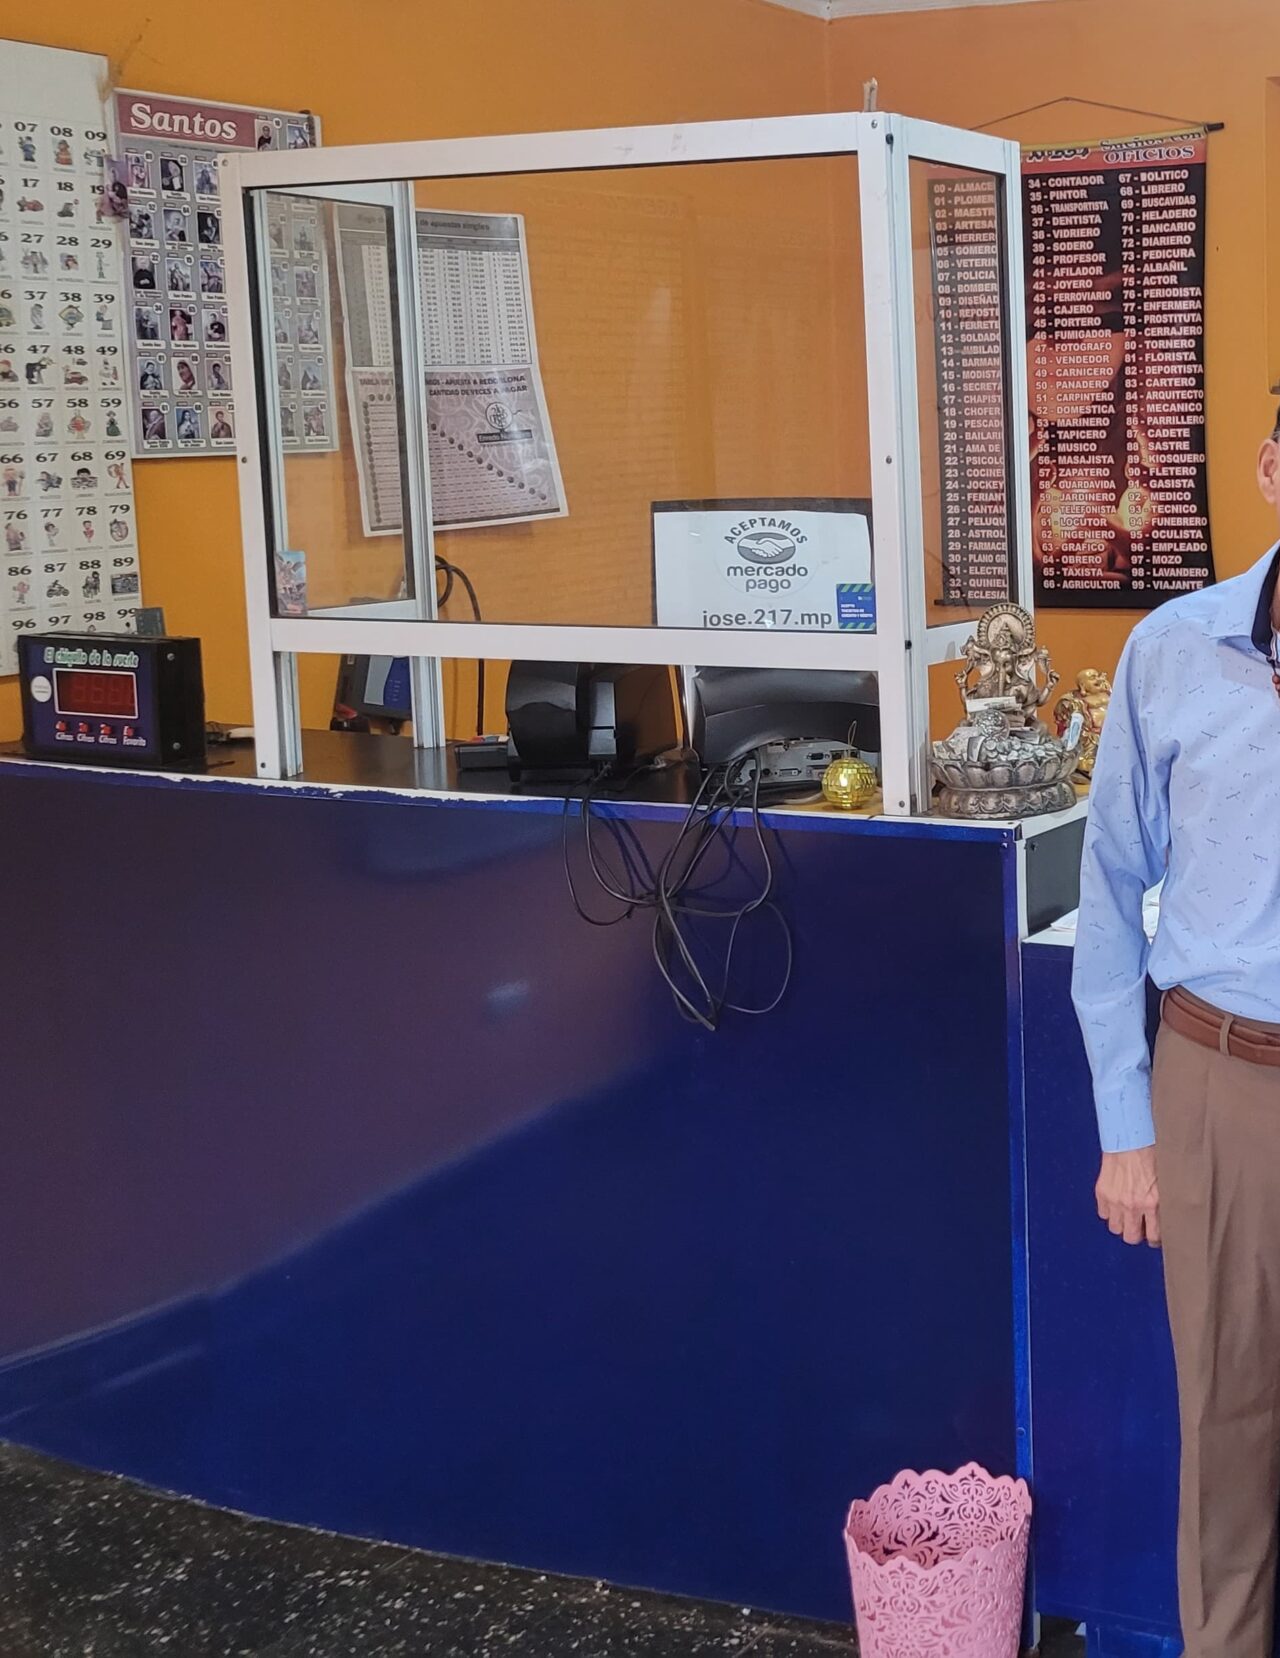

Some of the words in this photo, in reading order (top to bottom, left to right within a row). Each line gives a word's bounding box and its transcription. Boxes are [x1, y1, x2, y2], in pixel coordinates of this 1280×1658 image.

[131, 102, 237, 139] Santos
[14, 122, 38, 133] 07
[51, 126, 73, 137] 08
[85, 131, 107, 141] 09
[1104, 146, 1195, 164] OFICIOS
[57, 182, 73, 191] 18
[1028, 179, 1041, 188] 34
[1048, 175, 1104, 187] CONTADOR
[1120, 186, 1134, 196] 68
[1141, 183, 1185, 195] LIBRERO
[1122, 212, 1134, 222] 70
[1142, 208, 1197, 221] HELADERO
[1032, 217, 1044, 227] 37
[1052, 215, 1102, 225] DENTISTA
[21, 233, 44, 243] 27
[57, 236, 78, 246] 28
[90, 239, 112, 249] 29
[1032, 243, 1045, 253] 39
[1053, 241, 1094, 251] SODERO
[1033, 269, 1045, 278] 41
[1053, 266, 1103, 277] AFILADOR
[1122, 264, 1135, 274] 74
[1142, 261, 1187, 272] ALBAÑIL
[938, 272, 950, 281] 07
[957, 269, 995, 280] POLICIA
[24, 290, 47, 300] 37
[1123, 290, 1136, 299] 76
[1144, 288, 1202, 298] PERIODISTA
[1033, 306, 1046, 316] 44
[1054, 304, 1093, 315] CAJERO
[1034, 344, 1047, 353] 47
[1055, 342, 1112, 352] FOTOGRAFO
[1124, 340, 1137, 350] 80
[1144, 339, 1196, 349] TORNERO
[62, 345, 85, 355] 48
[96, 346, 117, 355] 49
[1035, 368, 1047, 377] 49
[1056, 367, 1113, 377] CARNICERO
[1125, 379, 1137, 388] 83
[1146, 377, 1196, 387] CARTERO
[32, 399, 54, 408] 57
[67, 399, 88, 408] 58
[944, 407, 956, 417] 18
[964, 407, 1001, 416] CHOFER
[1037, 418, 1049, 427] 53
[1057, 417, 1110, 427] MARINERO
[71, 452, 93, 461] 68
[105, 451, 125, 460] 69
[1039, 468, 1050, 477] 57
[1059, 468, 1110, 476] ZAPATERO
[1128, 480, 1140, 489] 91
[1150, 479, 1195, 488] GASISTA
[4, 510, 27, 519] 76
[109, 505, 130, 514] 79
[724, 517, 808, 544] ACEPTAMOS
[113, 557, 134, 567] 89
[1042, 555, 1054, 564] 64
[1061, 555, 1102, 564] OBRERO
[1131, 555, 1144, 564] 97
[1152, 555, 1182, 564] MOZO
[727, 564, 808, 577] mercado
[746, 576, 791, 592] pago
[49, 615, 72, 625] 97
[702, 608, 832, 628] jose.217.mp
